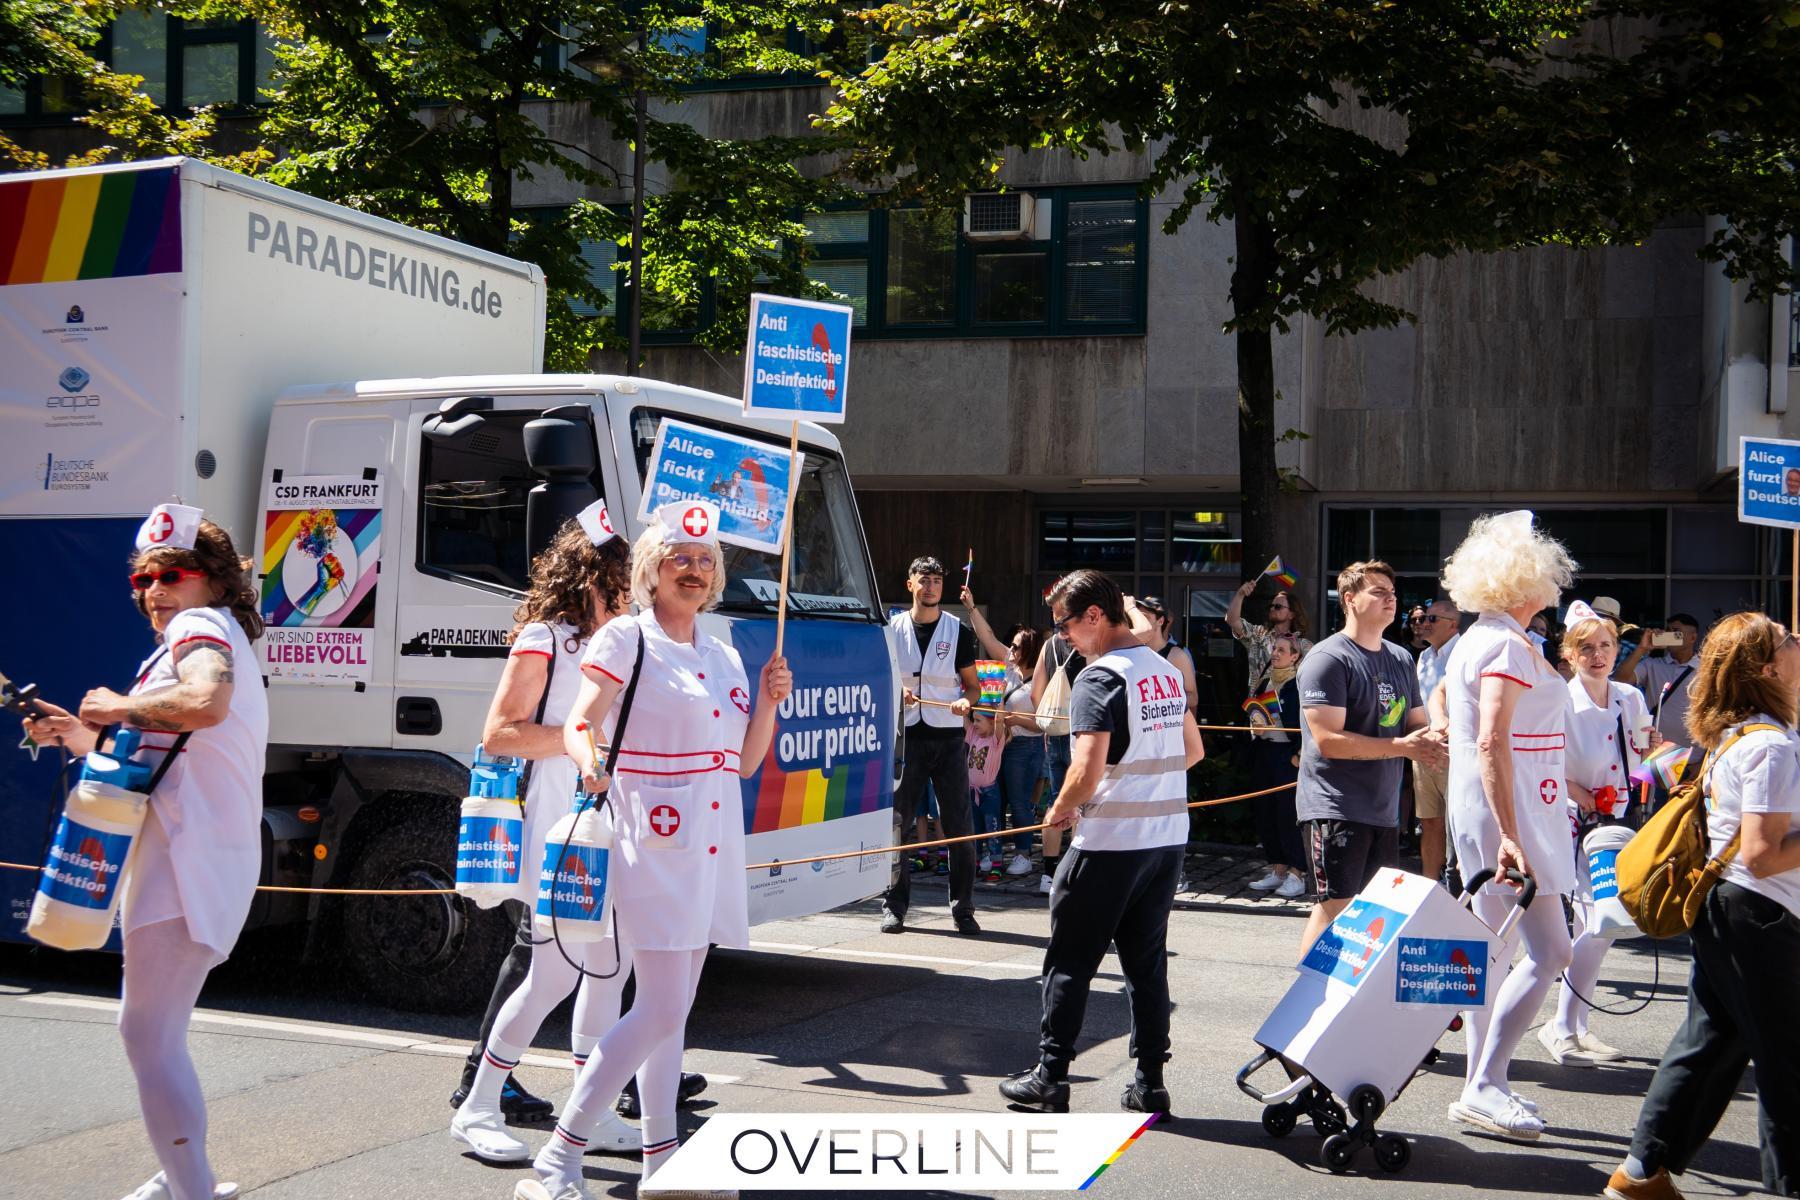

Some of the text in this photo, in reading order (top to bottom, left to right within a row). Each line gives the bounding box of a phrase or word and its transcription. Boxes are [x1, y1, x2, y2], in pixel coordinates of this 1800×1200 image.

[248, 212, 502, 318] PARADEKING.de
[759, 313, 787, 332] Anti
[758, 342, 842, 366] faschistische
[756, 368, 836, 391] Desinfektion
[668, 436, 715, 460] Alice
[53, 460, 95, 471] DEUTSCHE
[1748, 450, 1785, 465] Alice
[51, 471, 109, 482] BUNDESBANK
[662, 460, 705, 482] fickt
[1747, 470, 1781, 484] furzt
[275, 484, 378, 498] CSD FRANKFURT
[266, 631, 363, 644] WIR SIND EXTREM
[267, 644, 367, 664] LIEBEVOLL
[779, 684, 877, 720] our euro,
[779, 715, 882, 769] our pride.
[1401, 944, 1427, 956] Anti
[1400, 960, 1482, 976] faschistische
[1400, 978, 1476, 992] Desinfektion
